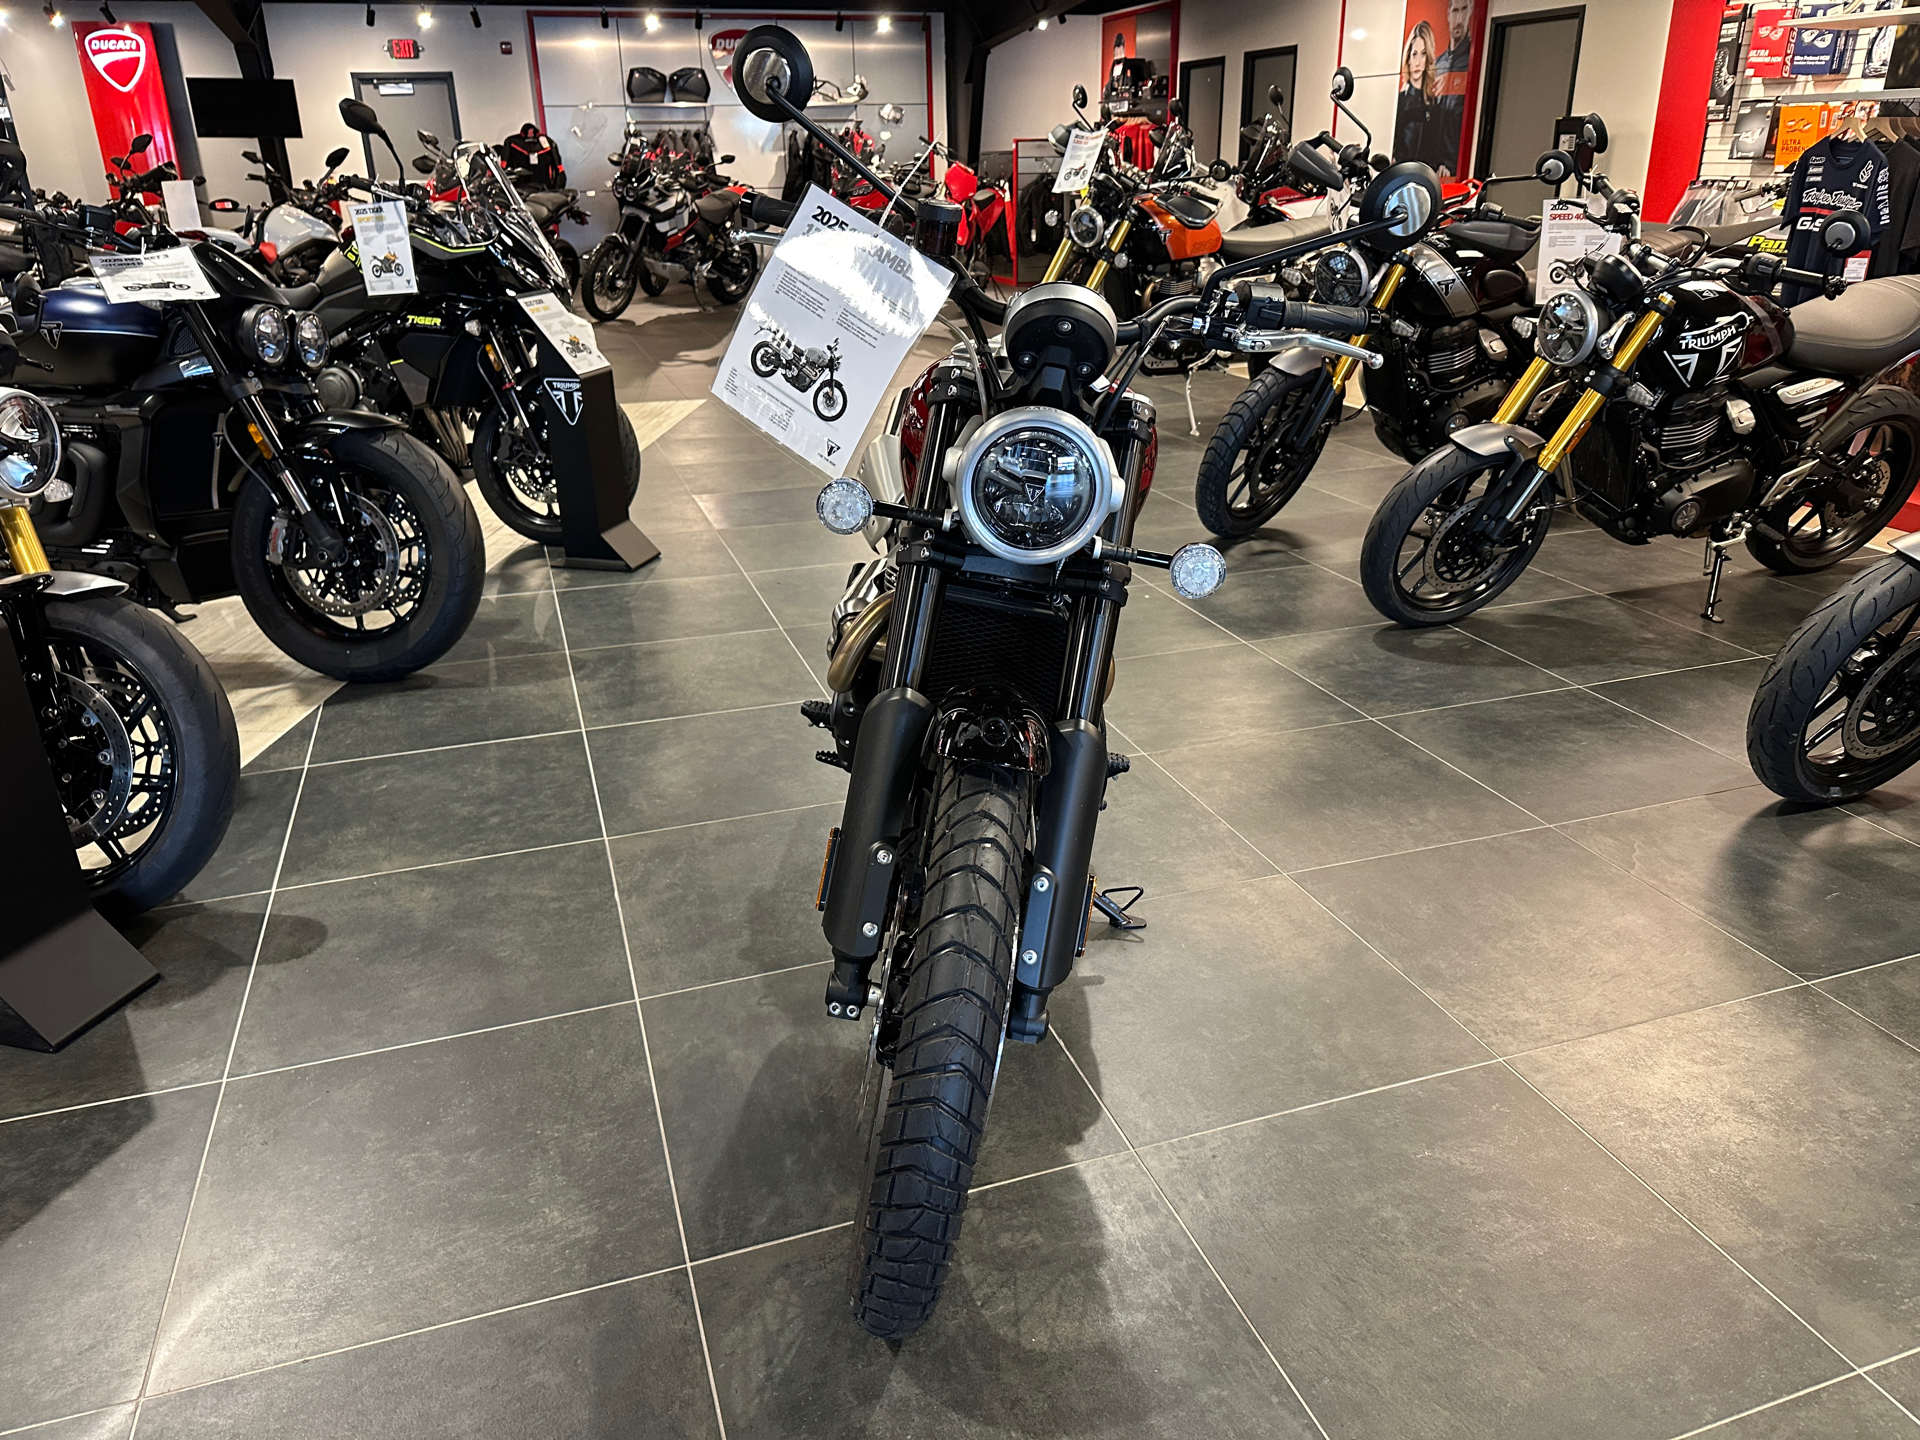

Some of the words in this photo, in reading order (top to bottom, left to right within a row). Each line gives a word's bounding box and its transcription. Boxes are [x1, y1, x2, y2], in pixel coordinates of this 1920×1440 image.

[91, 39, 137, 50] DUCATI
[392, 39, 414, 58] EXIT
[1782, 8, 1802, 77] GASGS
[1749, 49, 1769, 57] ULTRA
[812, 206, 848, 232] 2025
[407, 314, 442, 326] TIGER
[1679, 326, 1736, 350] TRIUMPH
